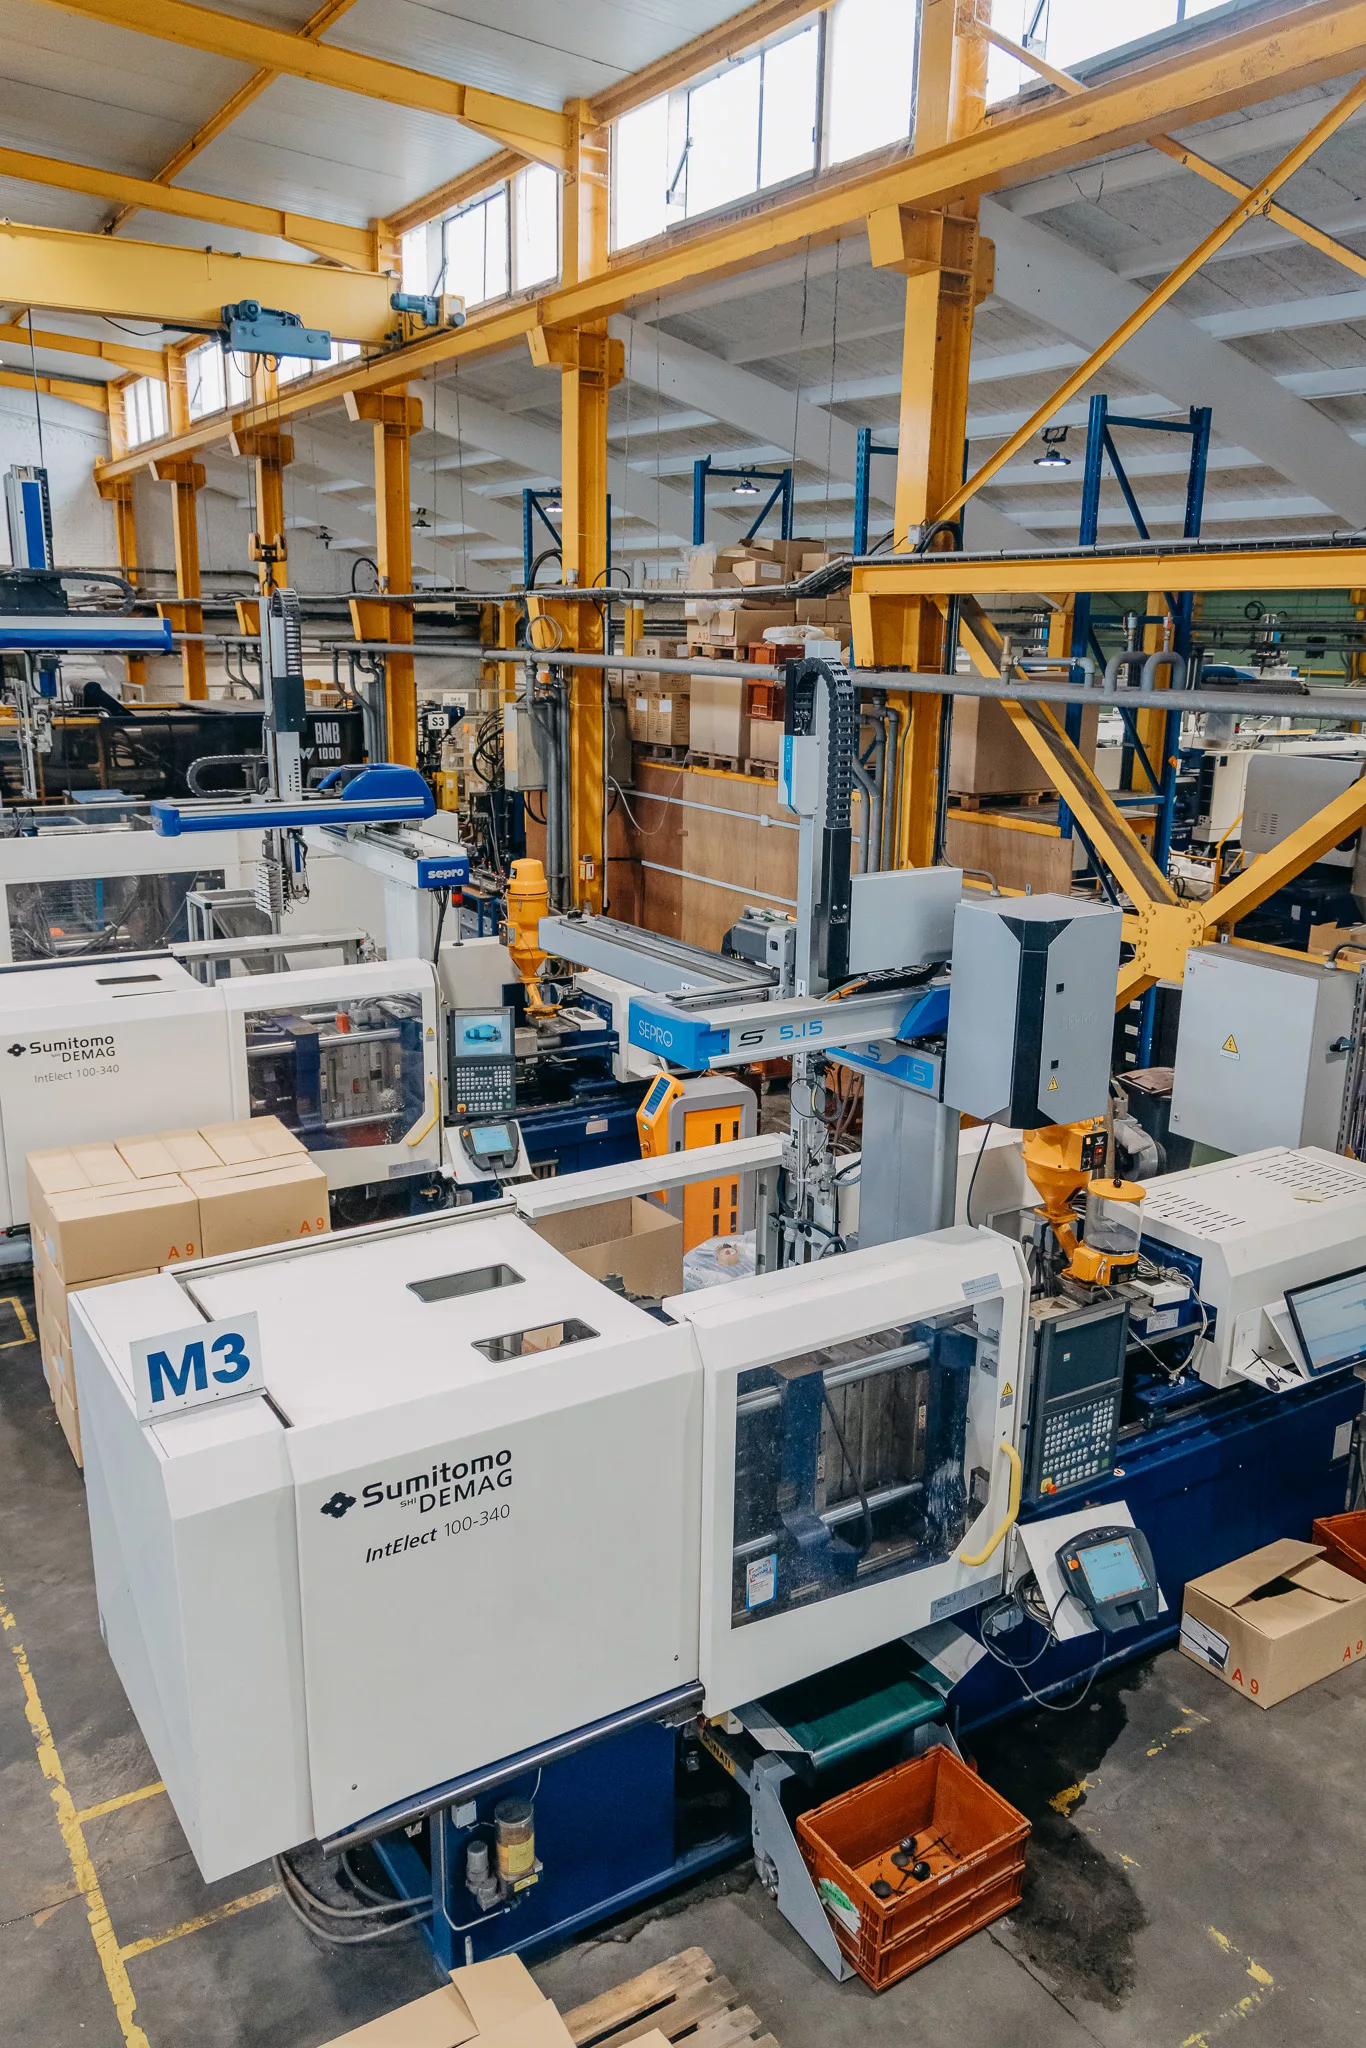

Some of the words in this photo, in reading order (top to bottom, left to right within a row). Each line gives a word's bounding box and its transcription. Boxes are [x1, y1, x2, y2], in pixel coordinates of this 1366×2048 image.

[432, 717, 445, 727] S3
[314, 722, 340, 744] BMB
[318, 747, 342, 760] 1000
[428, 868, 464, 880] sepro
[638, 1019, 673, 1048] SEPRO
[29, 1036, 114, 1055] Sumitomo
[61, 1046, 116, 1063] DEMAG
[34, 1071, 73, 1083] IntElect
[77, 1064, 120, 1078] 100-340
[300, 1220, 311, 1234] A
[316, 1217, 325, 1231] 9
[167, 1246, 180, 1260] A
[185, 1243, 195, 1256] 9
[147, 1332, 251, 1404] M3
[362, 1449, 512, 1508] Sumitomo
[400, 1497, 417, 1508] SHI
[419, 1468, 512, 1514] DEMAG
[365, 1527, 438, 1564] IntElect
[444, 1504, 511, 1537] 100-340
[1343, 1646, 1351, 1662] A
[1356, 1639, 1363, 1655] 9
[1231, 1668, 1244, 1687] A
[1250, 1678, 1259, 1695] 9
